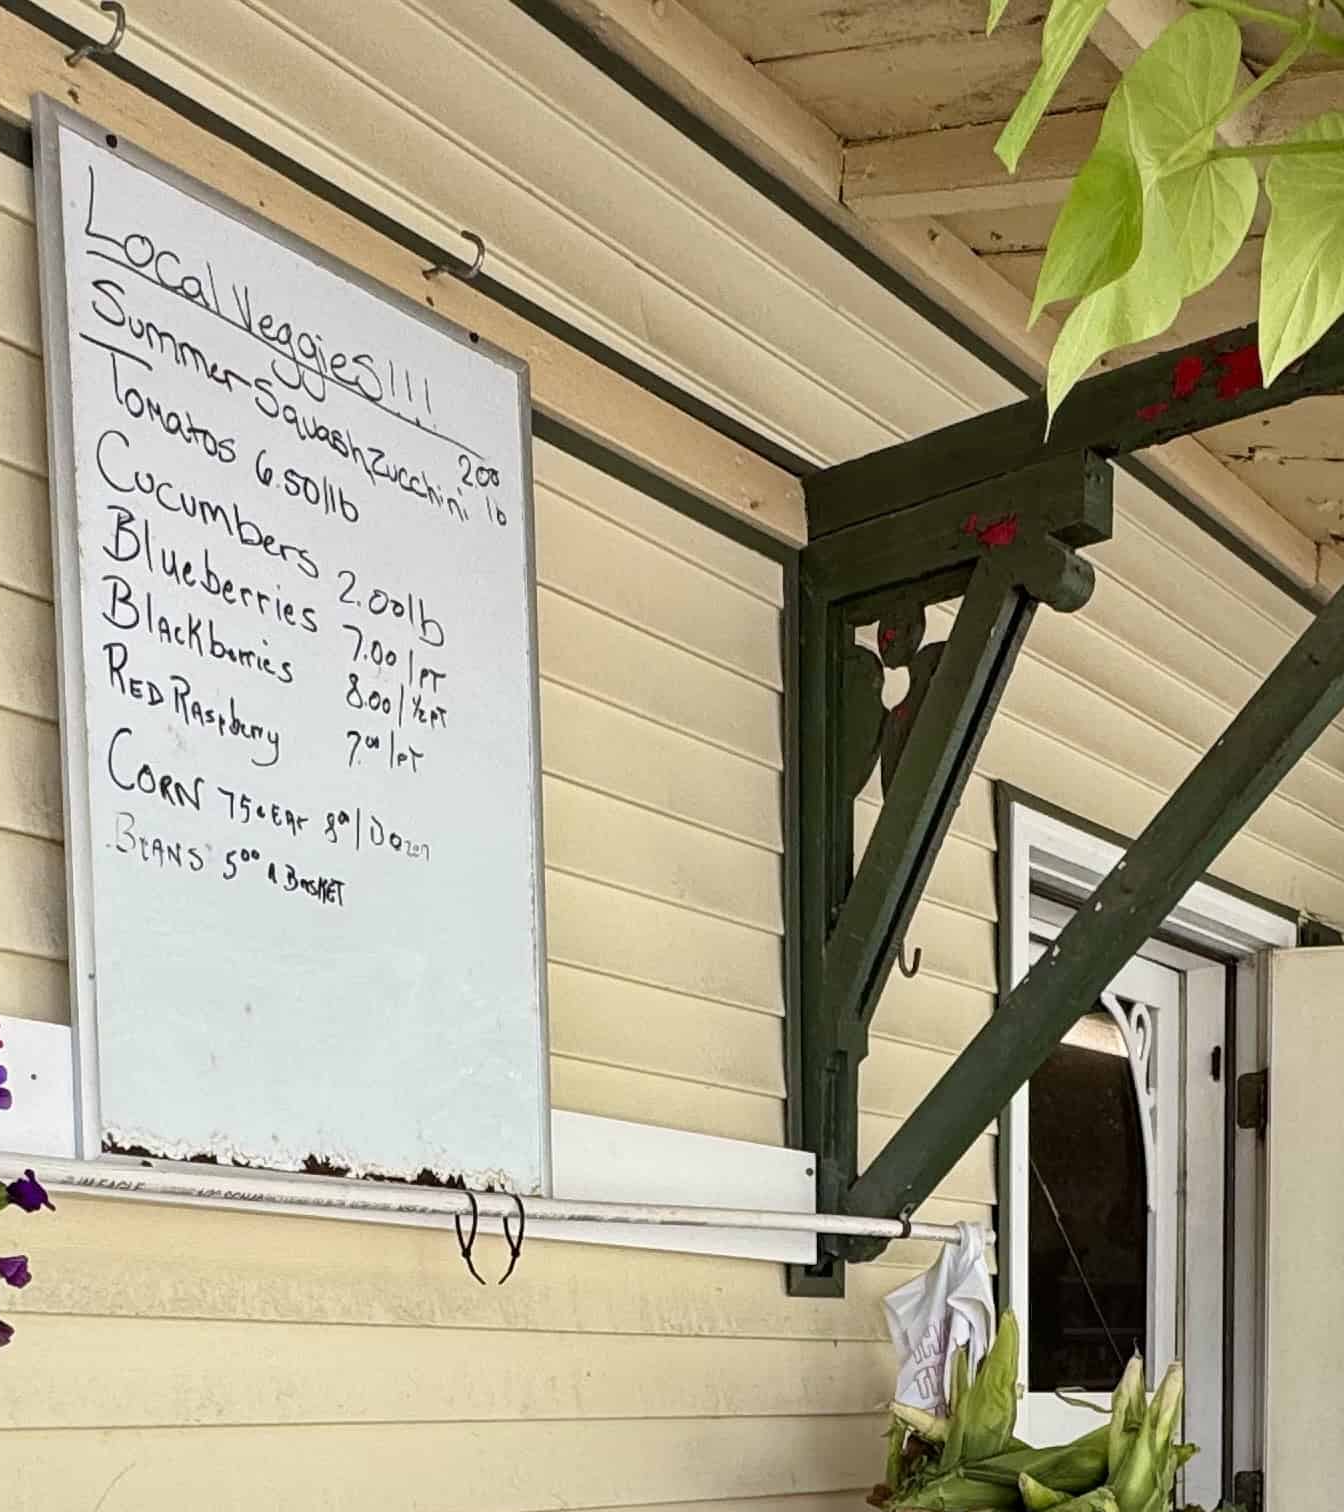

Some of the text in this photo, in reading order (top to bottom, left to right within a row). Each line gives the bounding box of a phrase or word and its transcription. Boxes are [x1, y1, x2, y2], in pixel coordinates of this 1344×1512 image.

[79, 332, 237, 464] Tomatos
[91, 279, 253, 393] Summer
[367, 447, 470, 522] Zucchini
[96, 429, 320, 579] Cucumbers
[102, 504, 319, 634] Blueberries
[102, 642, 164, 706] RED
[107, 726, 206, 812] CORN
